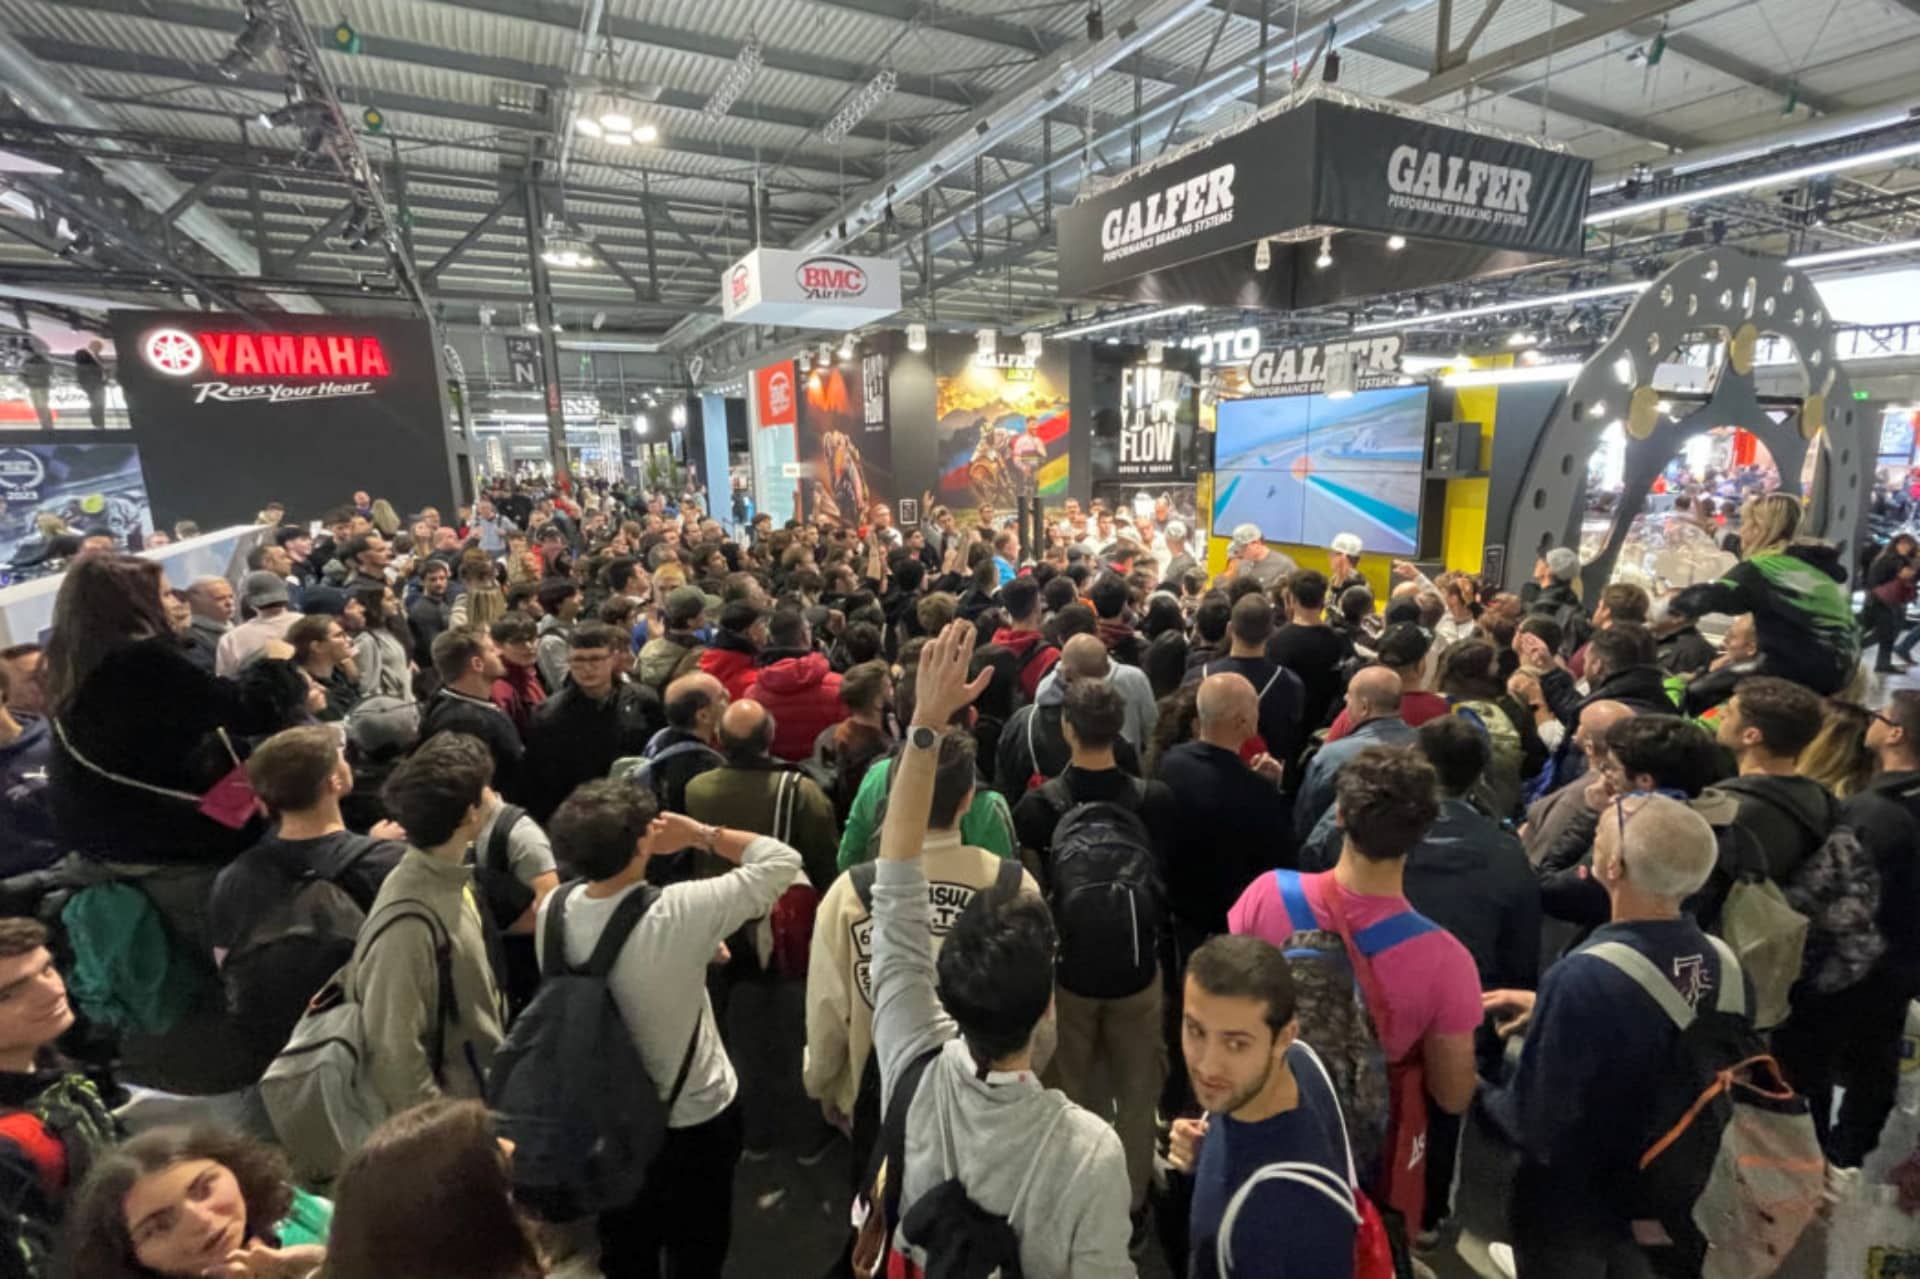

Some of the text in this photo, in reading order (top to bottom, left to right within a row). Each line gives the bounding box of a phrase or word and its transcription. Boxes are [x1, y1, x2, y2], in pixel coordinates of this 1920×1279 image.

[1387, 144, 1532, 214] GALFER
[1101, 163, 1236, 251] GALFER
[1388, 193, 1528, 228] PERFORMANCE BRAKING SYSTEMS
[1155, 223, 1193, 247] BRAKING
[1194, 208, 1234, 234] SYSTEMS
[803, 266, 862, 291] BMC
[200, 332, 390, 377] YAMAHA
[1167, 327, 1260, 366] OTO
[192, 381, 266, 403] Revs
[268, 382, 318, 402] Your
[514, 363, 535, 383] N
[1119, 421, 1175, 462] FLOW
